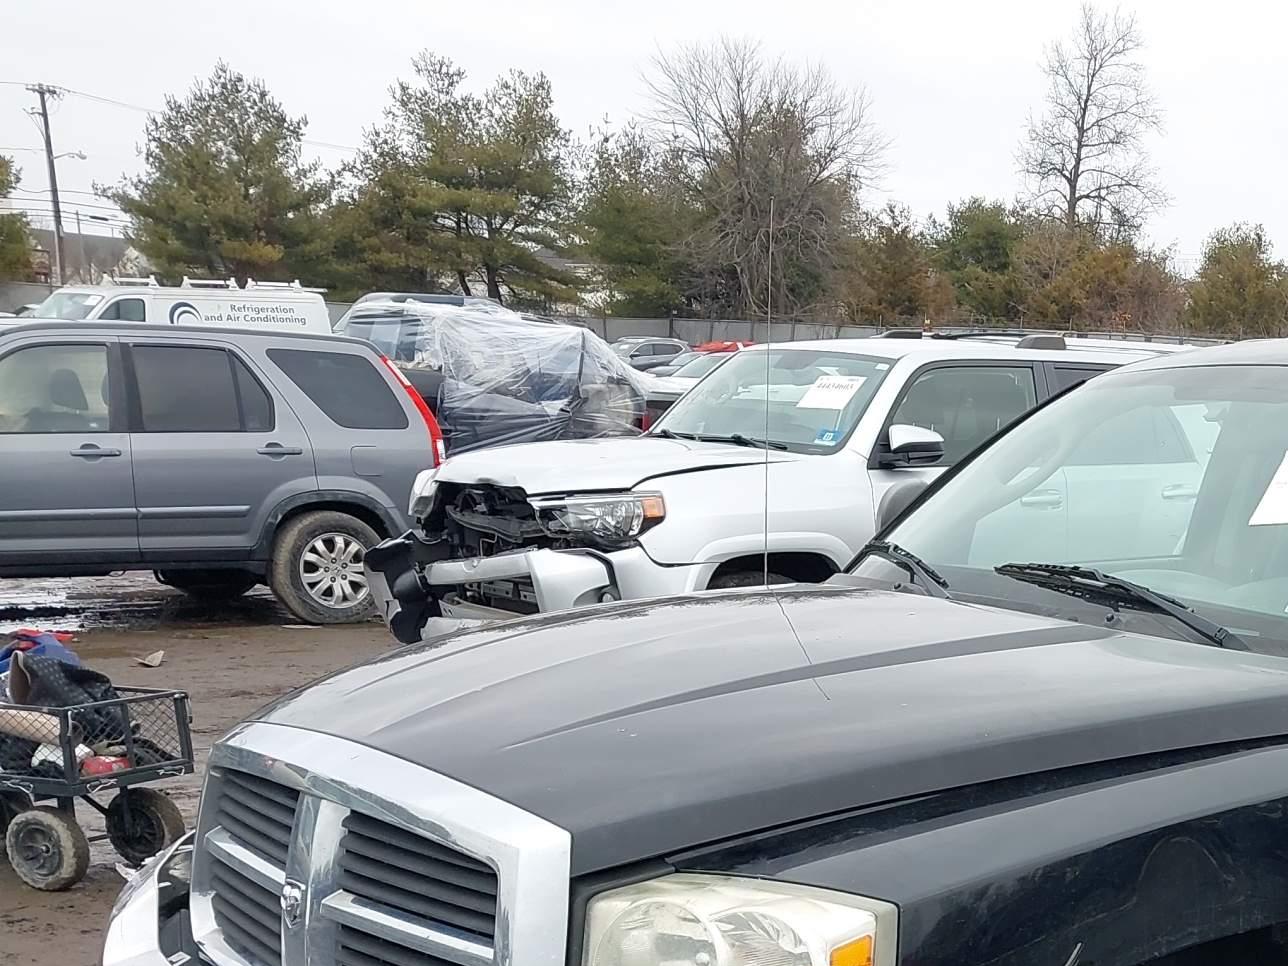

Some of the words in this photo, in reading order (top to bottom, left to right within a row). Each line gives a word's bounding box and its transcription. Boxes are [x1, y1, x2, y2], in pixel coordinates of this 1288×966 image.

[230, 304, 295, 315] Refrigeration
[204, 314, 223, 322] and
[226, 314, 240, 322] Air
[243, 315, 307, 325] Conditioning
